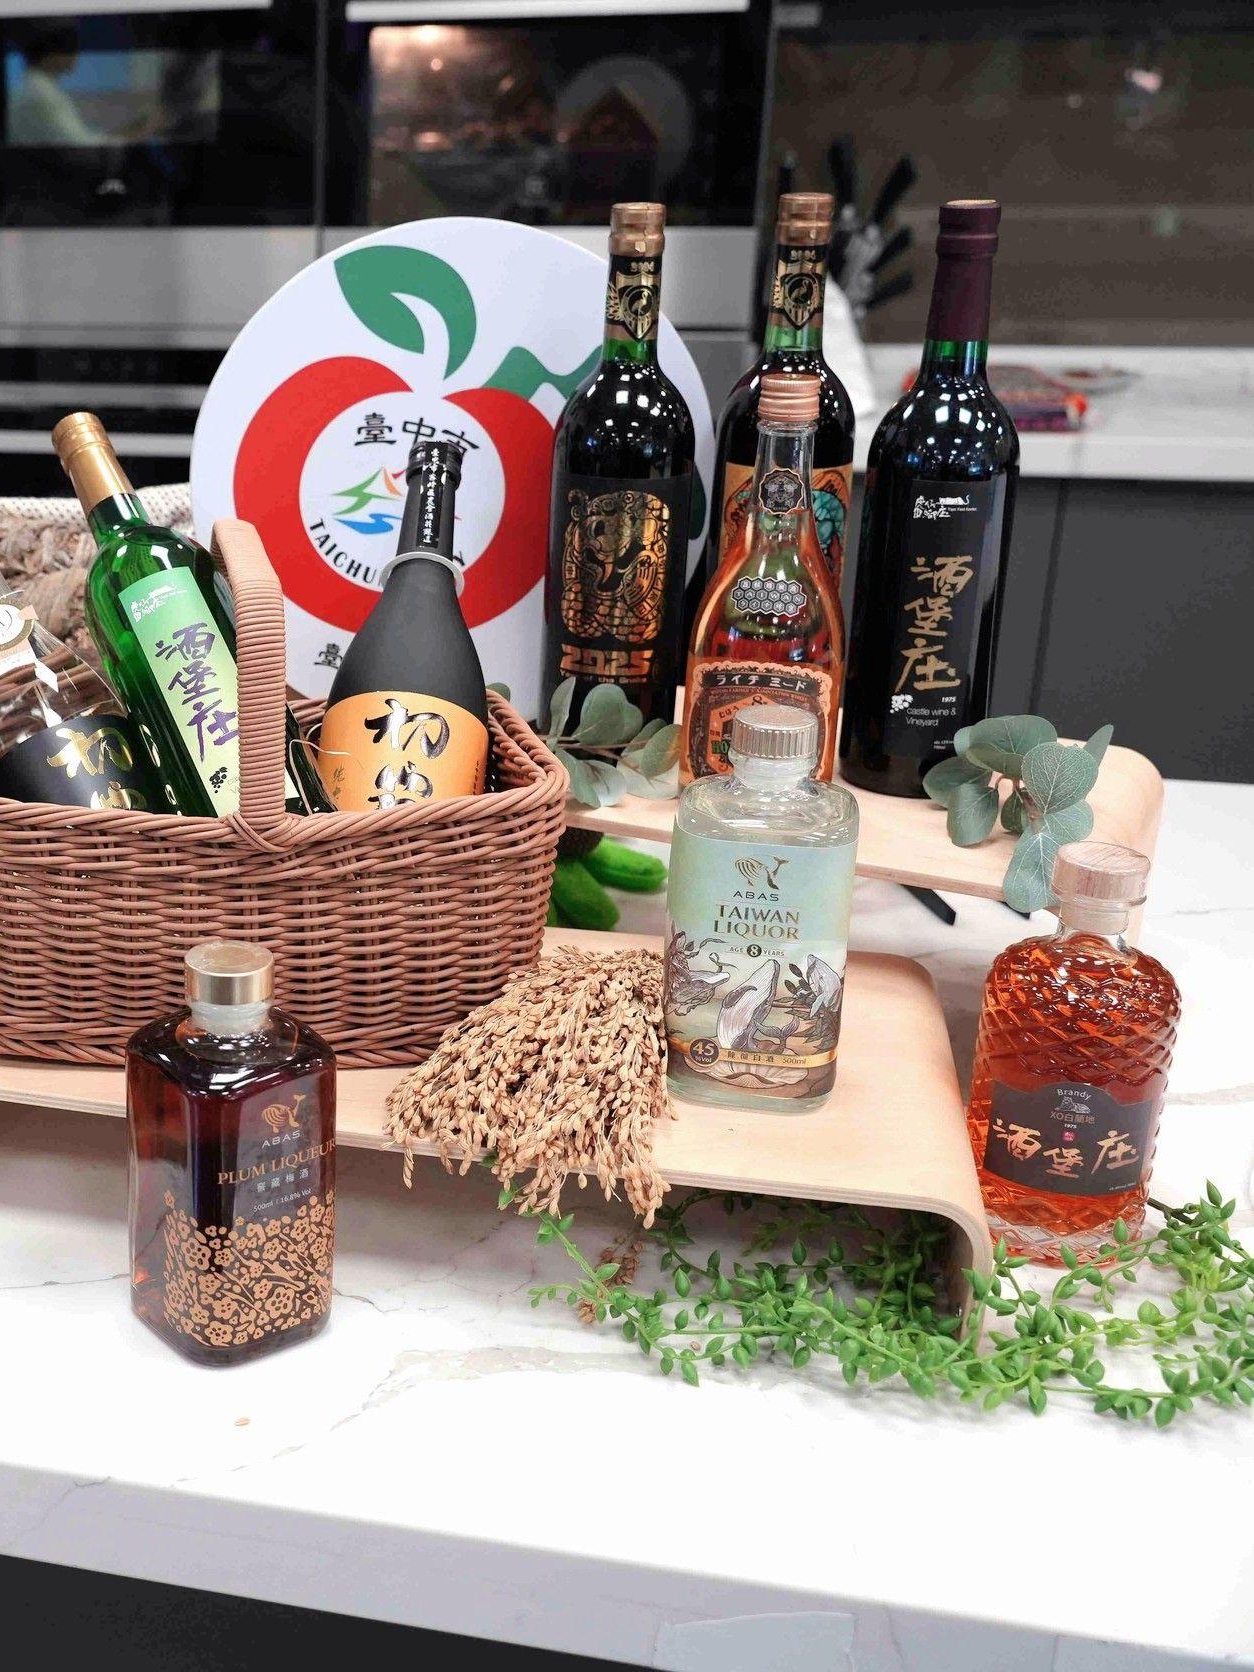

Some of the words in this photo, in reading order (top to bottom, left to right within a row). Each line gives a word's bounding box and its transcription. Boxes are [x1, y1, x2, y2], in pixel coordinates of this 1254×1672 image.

[310, 518, 379, 585] TAICHU
[733, 890, 779, 902] ABAS
[716, 904, 800, 925] TAIWAN
[713, 920, 799, 940] LIQUOR
[763, 949, 785, 957] YEARS
[692, 1041, 715, 1056] 45
[1057, 1088, 1092, 1101] Brandy
[261, 1130, 301, 1149] ABAS
[217, 1162, 266, 1185] PLUM
[271, 1138, 336, 1171] LIQUEUR
